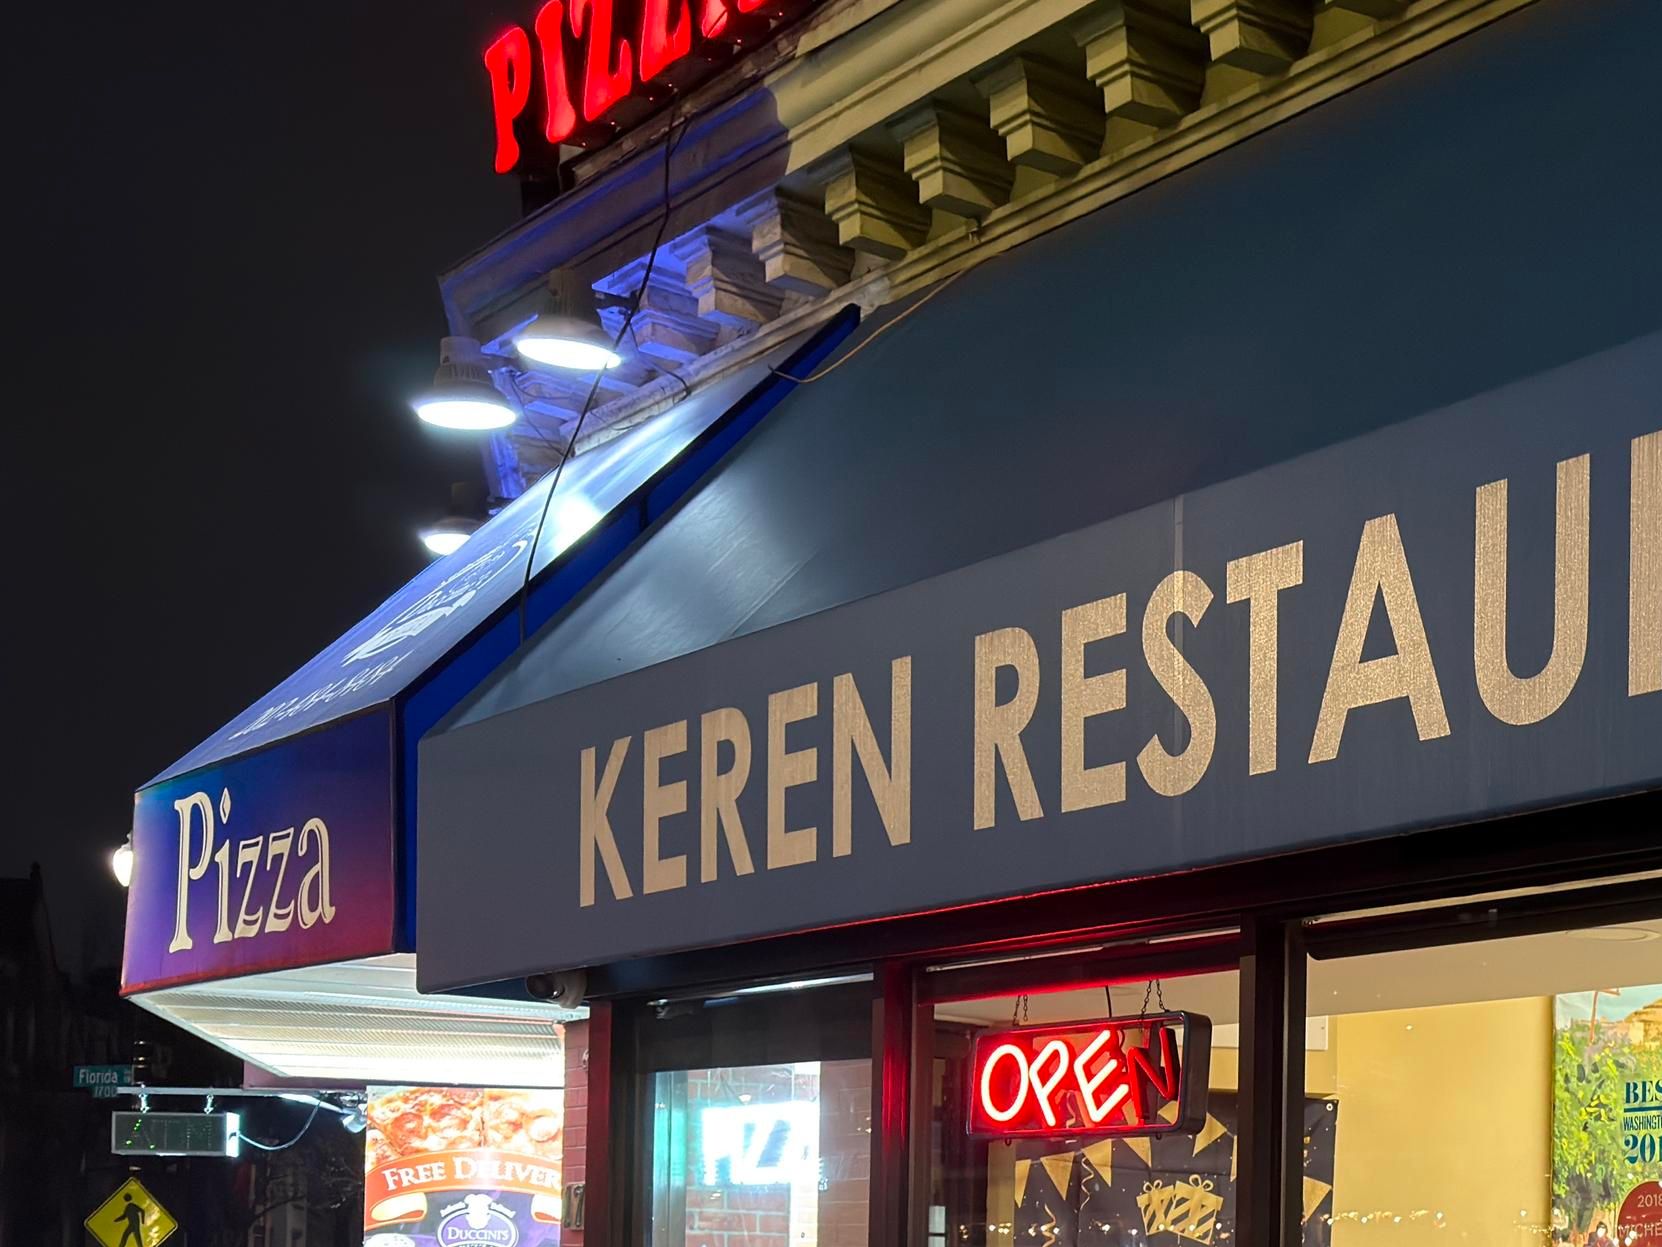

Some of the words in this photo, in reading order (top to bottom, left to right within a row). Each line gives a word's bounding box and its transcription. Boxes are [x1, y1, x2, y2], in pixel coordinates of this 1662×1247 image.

[484, 0, 772, 174] PIZZ
[579, 655, 912, 908] KEREN
[168, 787, 336, 955] Pizza
[79, 1068, 118, 1084] Florida
[980, 1026, 1178, 1127] OPEN
[382, 1161, 447, 1191] FREE
